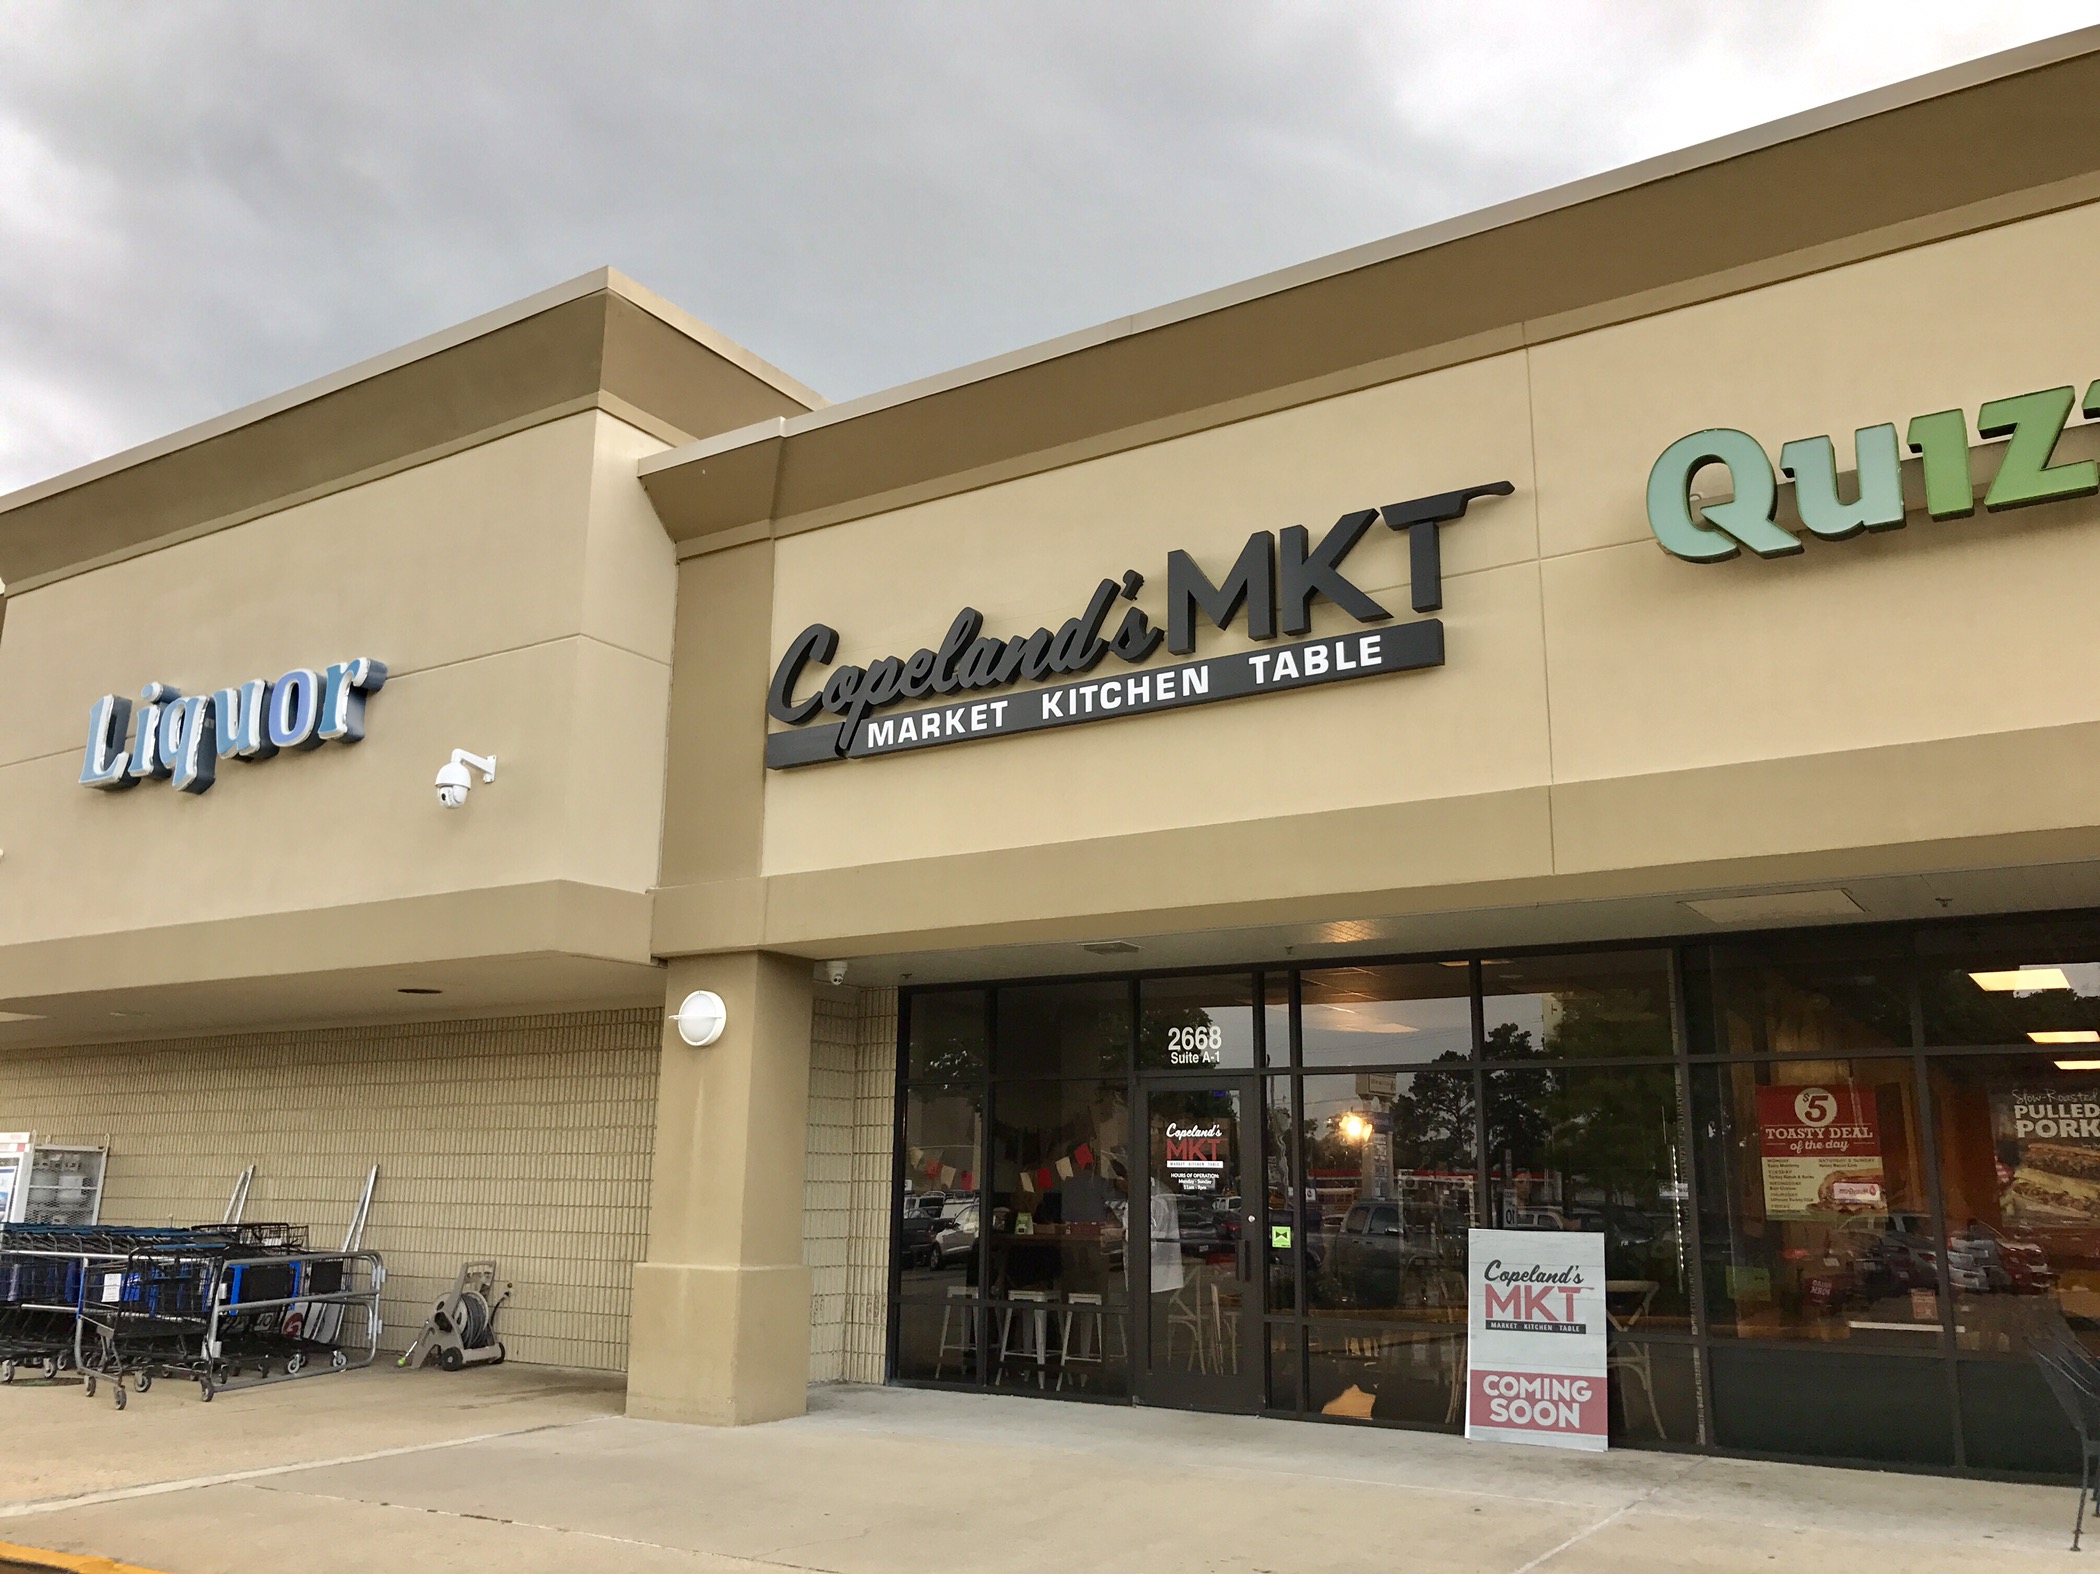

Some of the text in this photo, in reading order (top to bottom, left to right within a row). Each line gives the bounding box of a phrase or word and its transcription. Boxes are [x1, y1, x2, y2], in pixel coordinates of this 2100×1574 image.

[1646, 379, 2100, 563] Quiz
[767, 480, 1516, 758] Copeland's MKT
[867, 635, 1383, 749] MARKET KITCHEN TABLE
[78, 657, 388, 795] Liquor
[1168, 1026, 1222, 1051] 2668
[1170, 1051, 1220, 1064] Suite A-1
[2014, 1104, 2100, 1119] PULLED
[1166, 1122, 1222, 1140] Copeland's
[1766, 1127, 1873, 1139] TOASTY DEAL
[2015, 1119, 2100, 1138] PORK
[1167, 1138, 1228, 1161] MKT
[1790, 1139, 1849, 1154] of the day
[1484, 1259, 1584, 1287] Copeland's
[1485, 1284, 1595, 1322] MKT
[1490, 1322, 1580, 1332] MARKET KITCHEN TABLE
[1483, 1375, 1592, 1402] COMING
[1489, 1399, 1580, 1428] SOON
